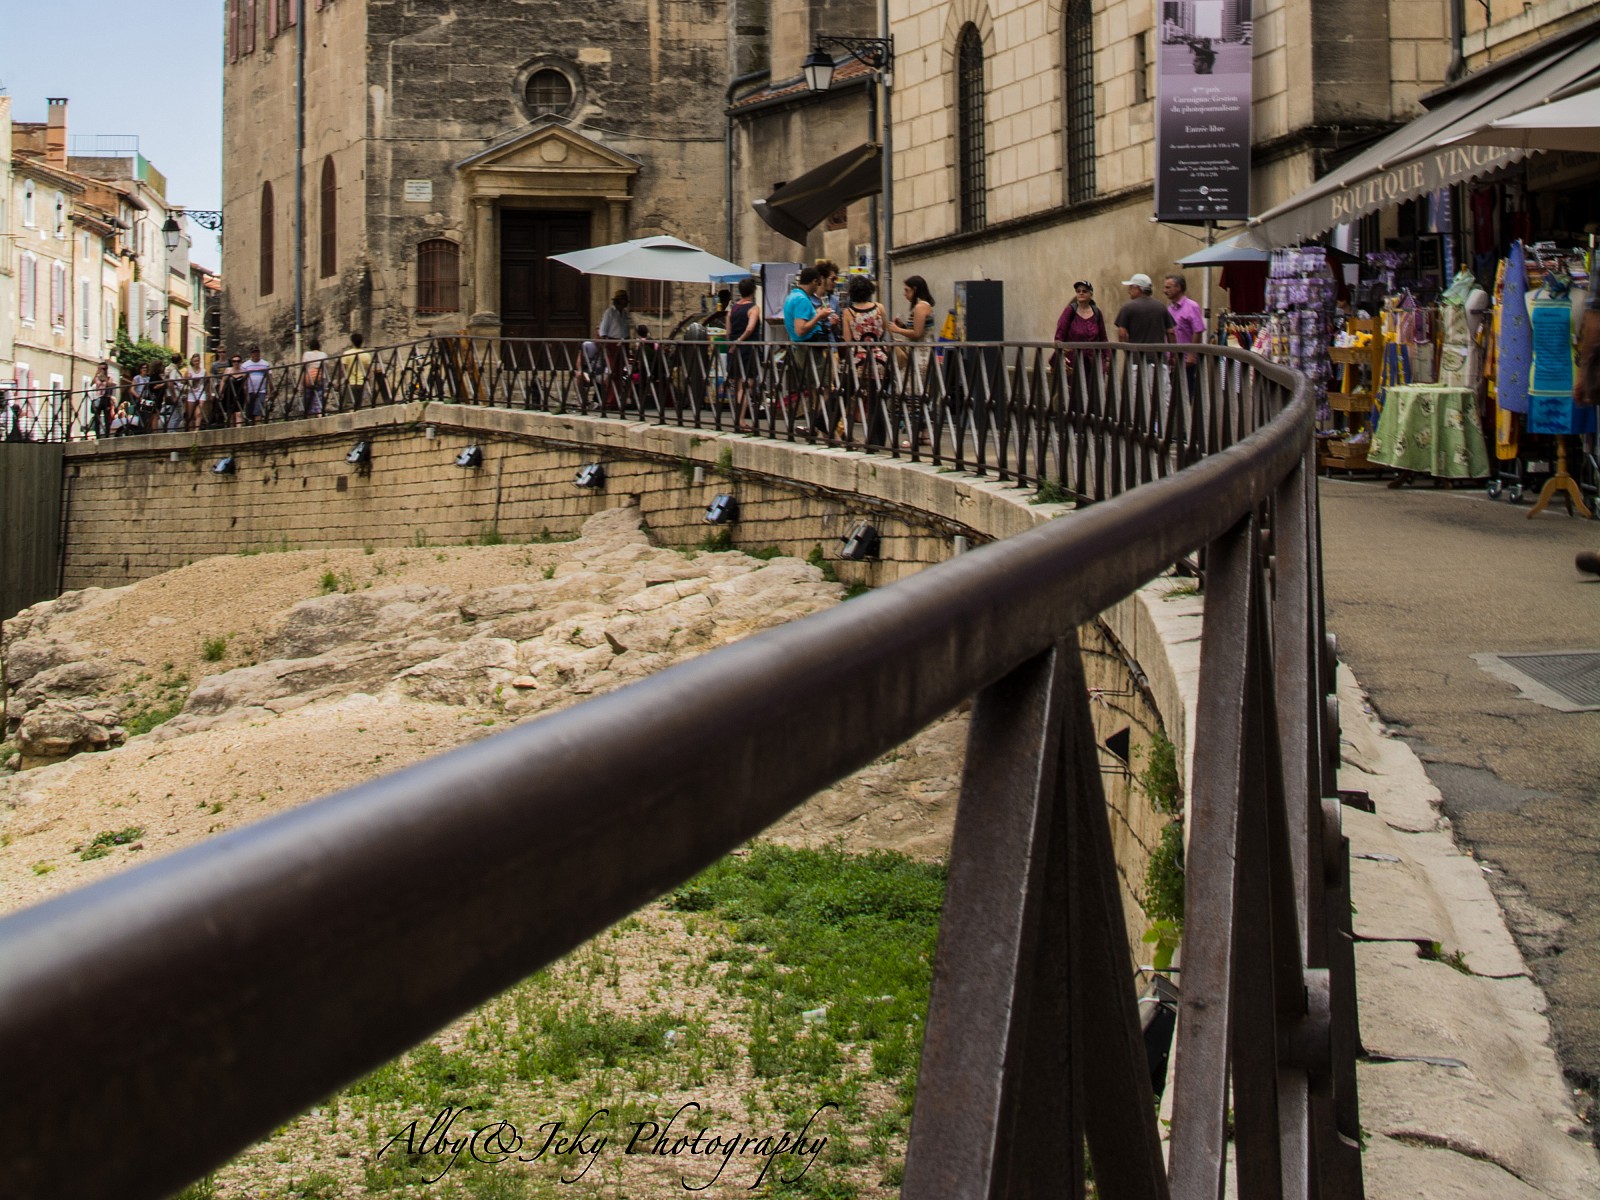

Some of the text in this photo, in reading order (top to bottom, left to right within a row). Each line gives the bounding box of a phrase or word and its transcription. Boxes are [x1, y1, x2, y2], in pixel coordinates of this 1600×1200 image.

[1170, 104, 1240, 114] du photojournalisme
[1184, 124, 1226, 133] Entrée libre
[1331, 160, 1425, 220] BOUTIQUE
